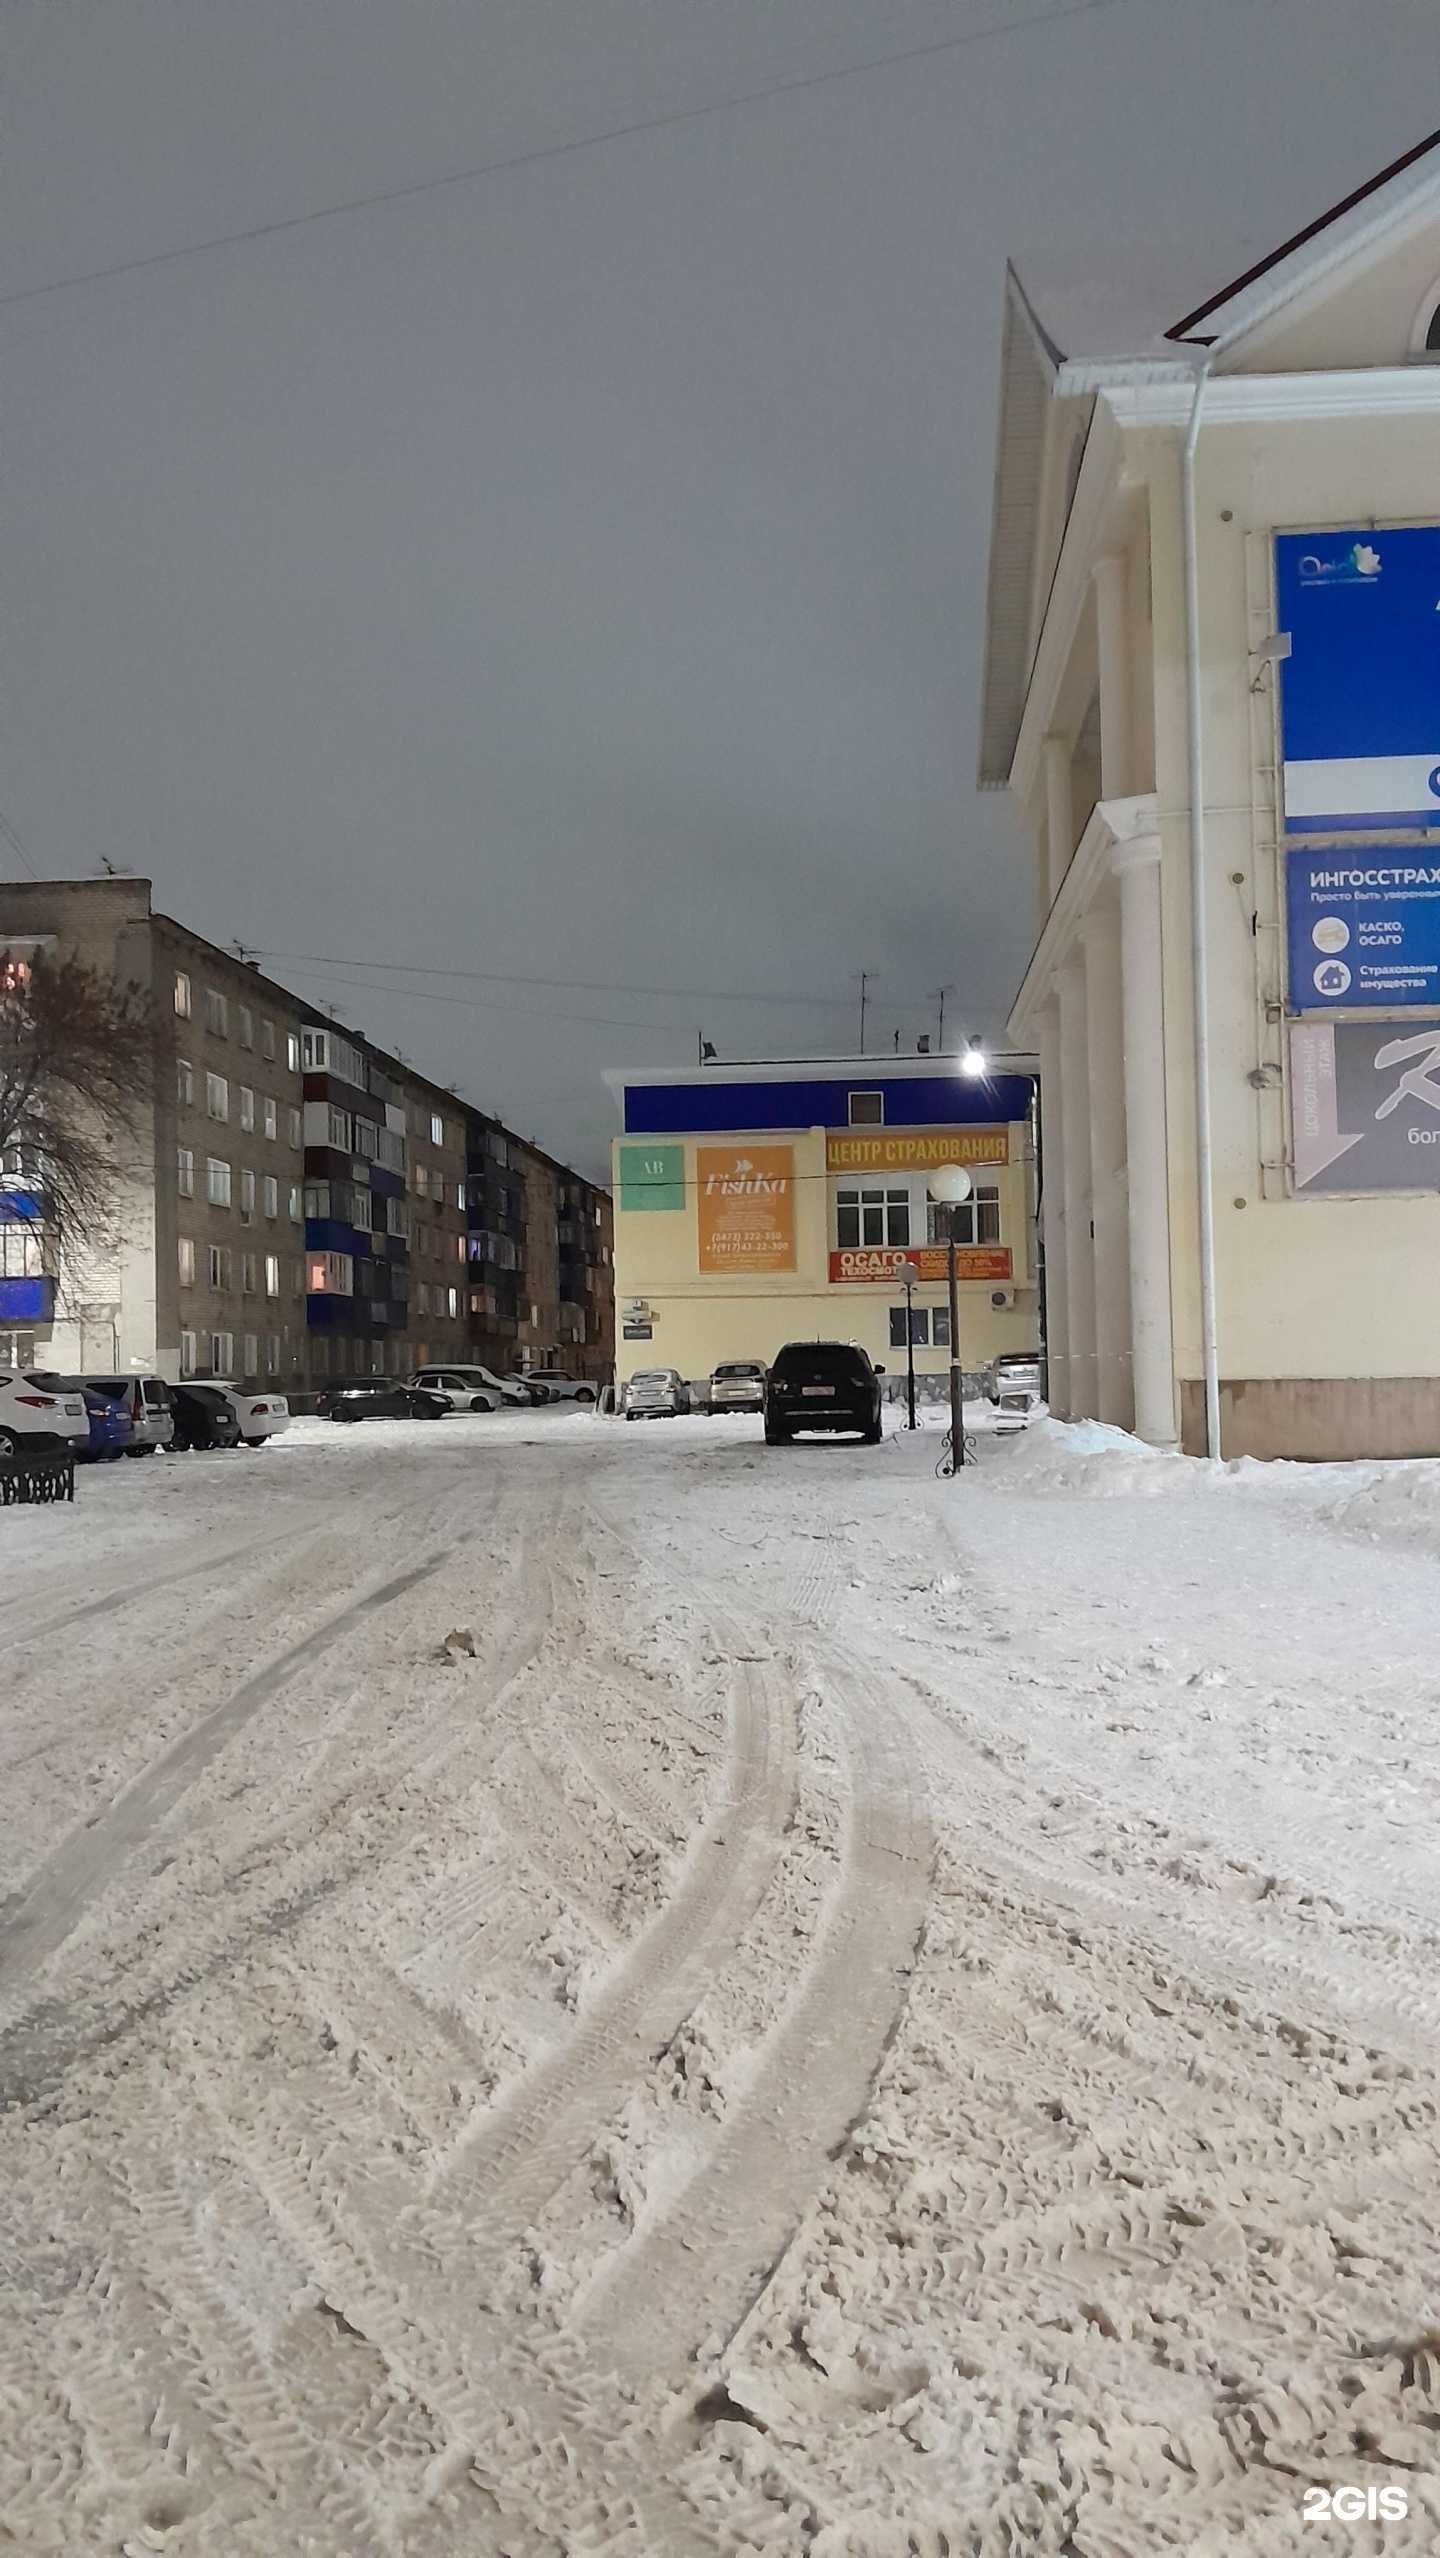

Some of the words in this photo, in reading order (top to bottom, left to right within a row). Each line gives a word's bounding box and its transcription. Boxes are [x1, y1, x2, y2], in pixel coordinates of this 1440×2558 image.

[1311, 892, 1352, 902] Просто
[1354, 890, 1382, 900] быть
[1359, 921, 1405, 932] КАСКО,
[1359, 935, 1402, 946] ОСАГО
[1360, 965, 1438, 976] Страхование
[1360, 979, 1427, 991] имущества
[829, 1140, 881, 1165] ЦЕНТР
[885, 1137, 1007, 1161] СТРАХОВАНИЯ
[840, 1251, 906, 1267] ОСАГО
[840, 1265, 899, 1276] ТЕХОСМОТ
